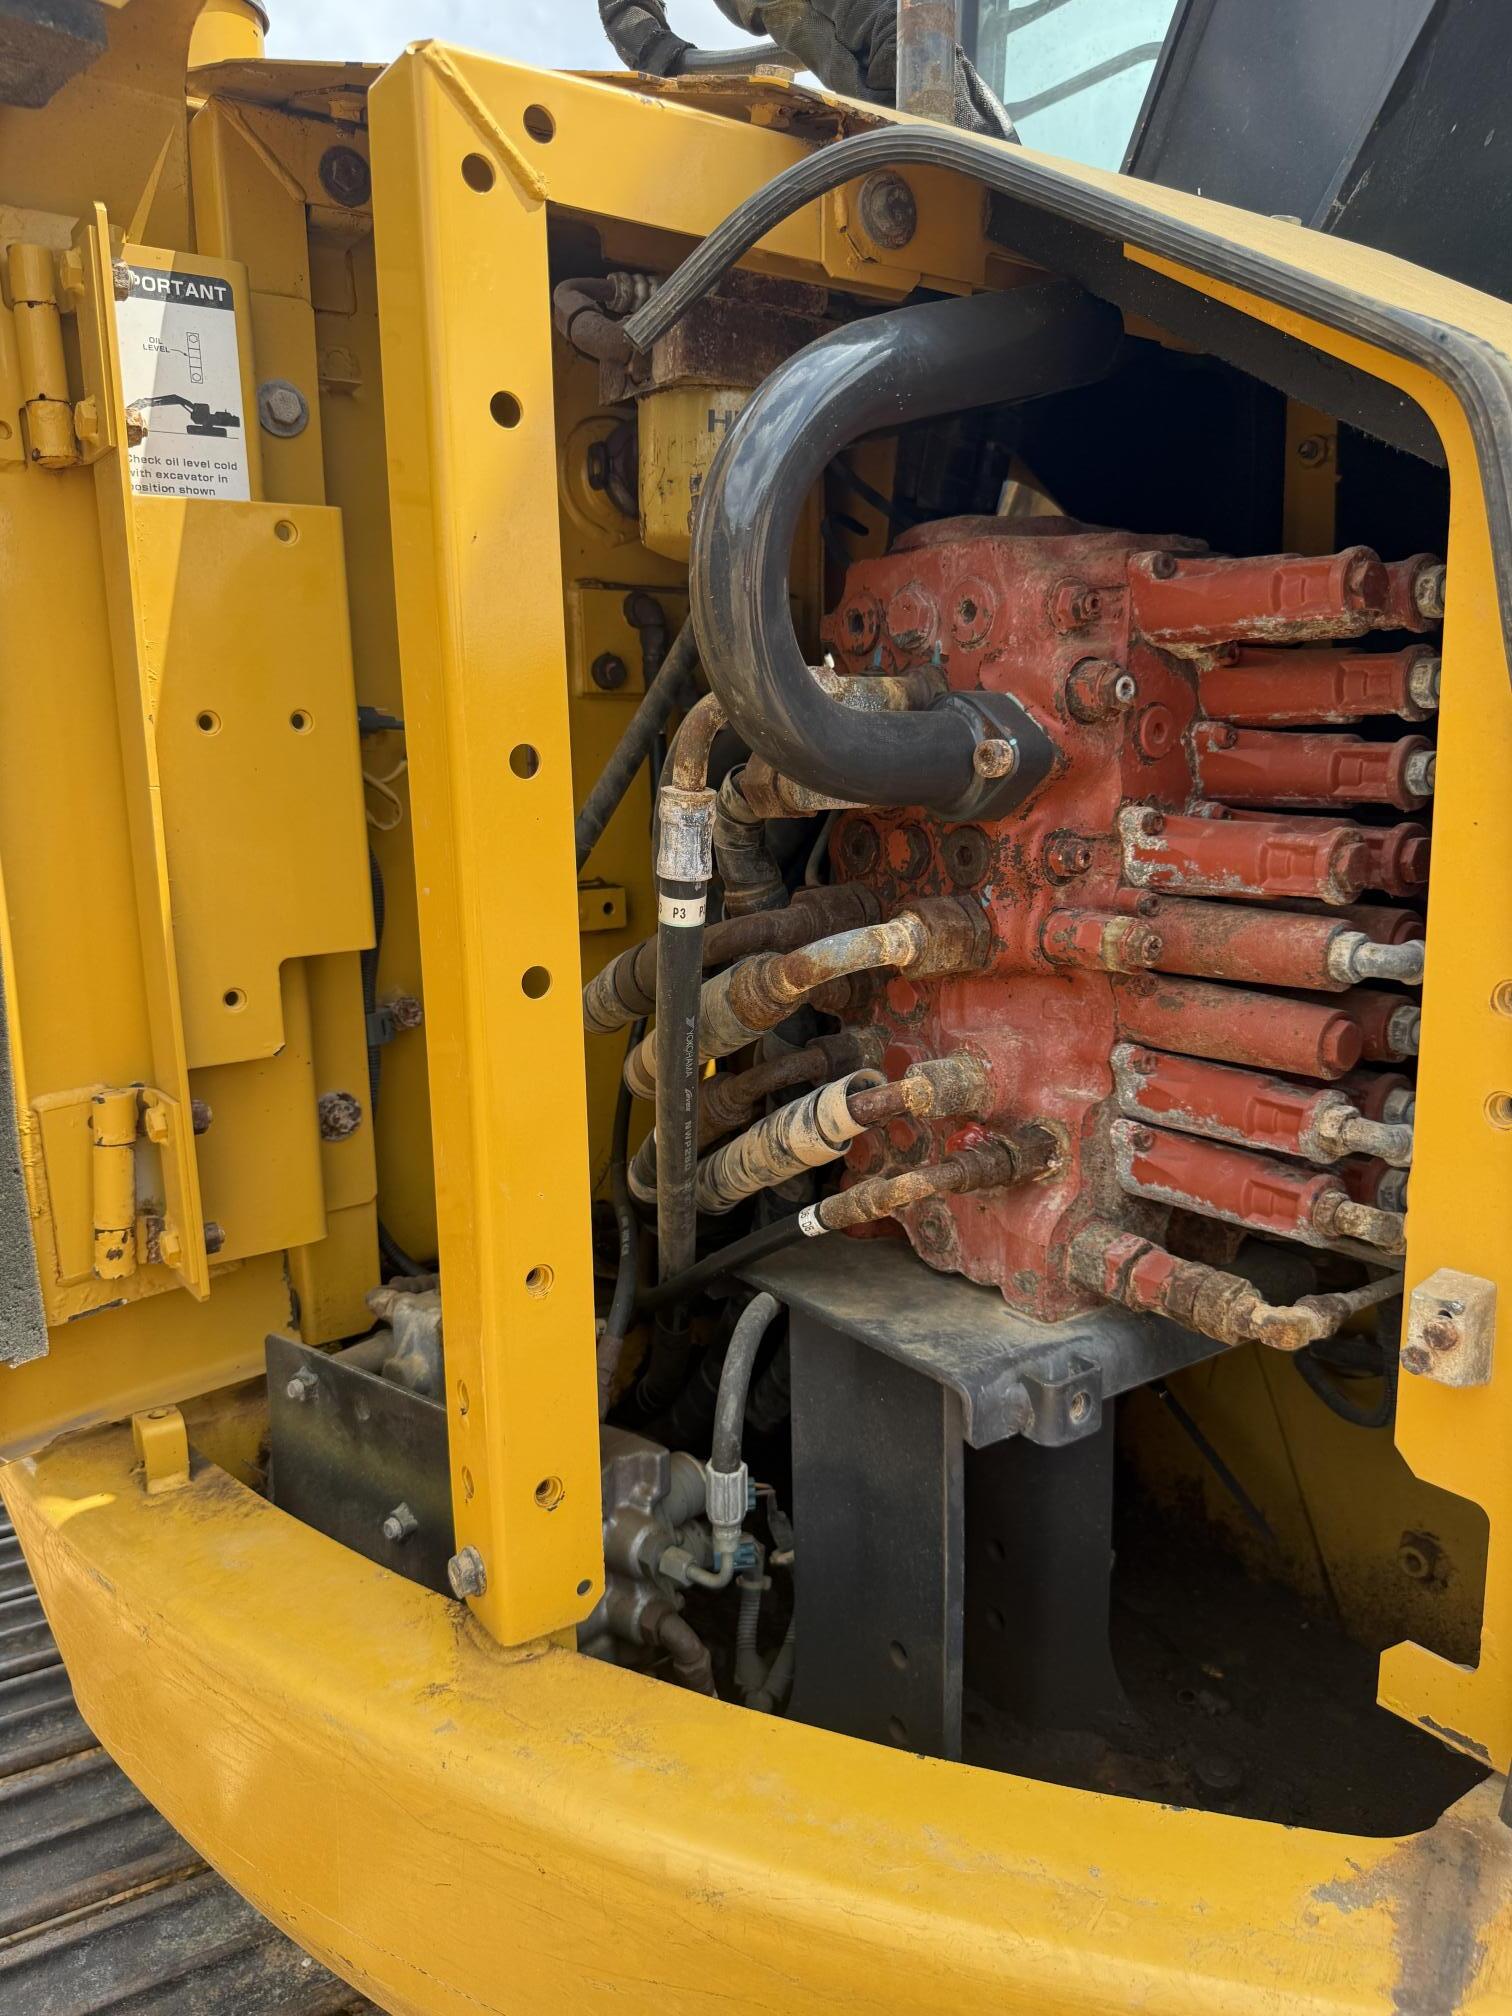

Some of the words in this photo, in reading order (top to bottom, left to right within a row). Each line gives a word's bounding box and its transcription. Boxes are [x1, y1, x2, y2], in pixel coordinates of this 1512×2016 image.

[148, 336, 163, 345] OIL
[142, 344, 170, 353] LEVEL
[708, 409, 738, 432] H
[165, 457, 180, 467] oil
[183, 458, 211, 470] level
[214, 461, 238, 471] cold
[155, 470, 214, 483] excavator
[217, 474, 229, 484] in
[130, 483, 176, 494] osition
[179, 486, 216, 496] shown
[672, 907, 686, 919] P3
[685, 1026, 695, 1078] YOKOHAMA
